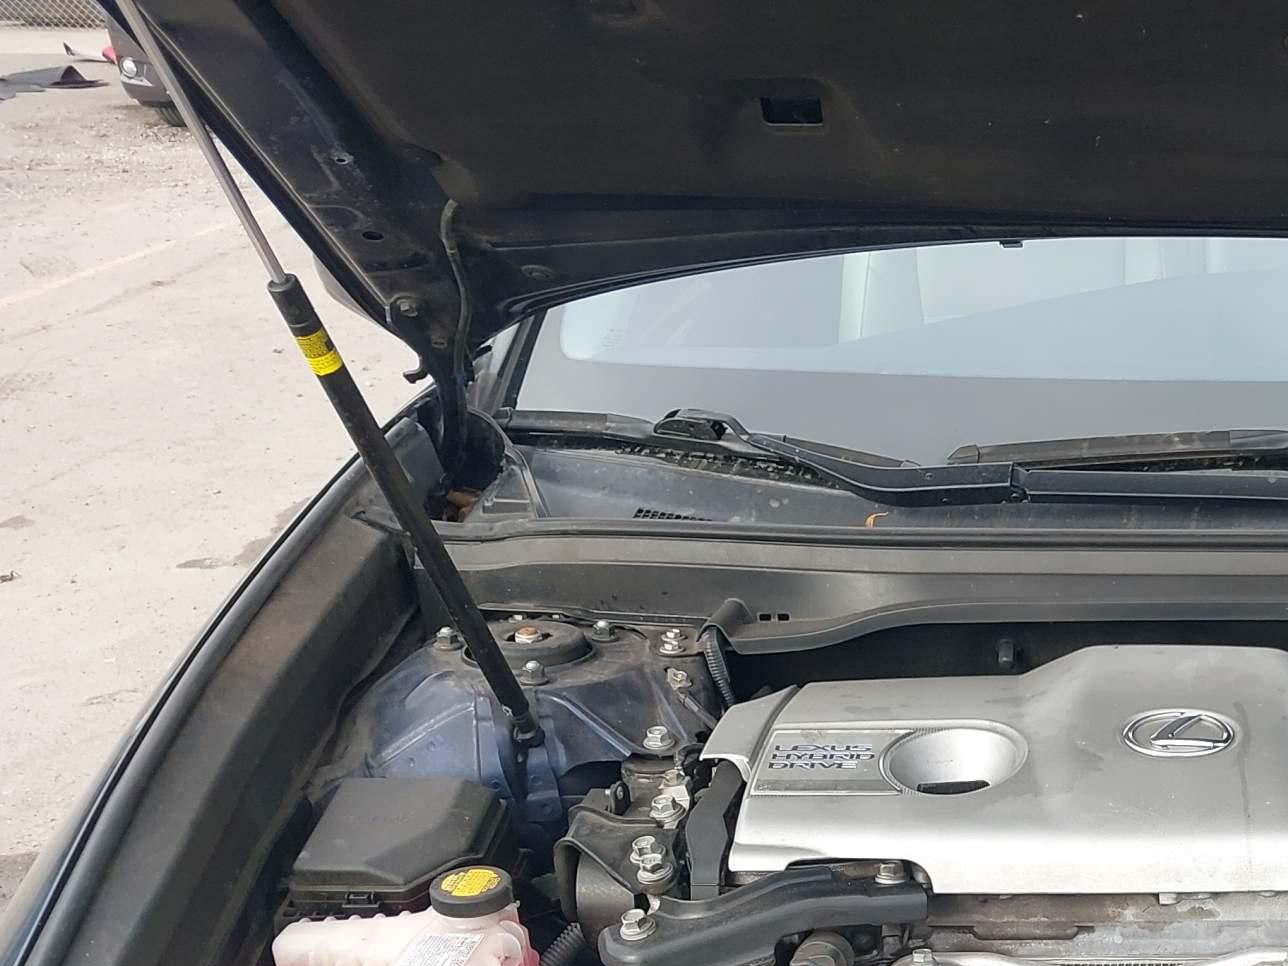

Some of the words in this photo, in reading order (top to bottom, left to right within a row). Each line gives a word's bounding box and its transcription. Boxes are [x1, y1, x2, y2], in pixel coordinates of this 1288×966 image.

[775, 744, 872, 752] LEXUS
[772, 752, 875, 760] HYBRID
[768, 760, 858, 769] DRIVE
